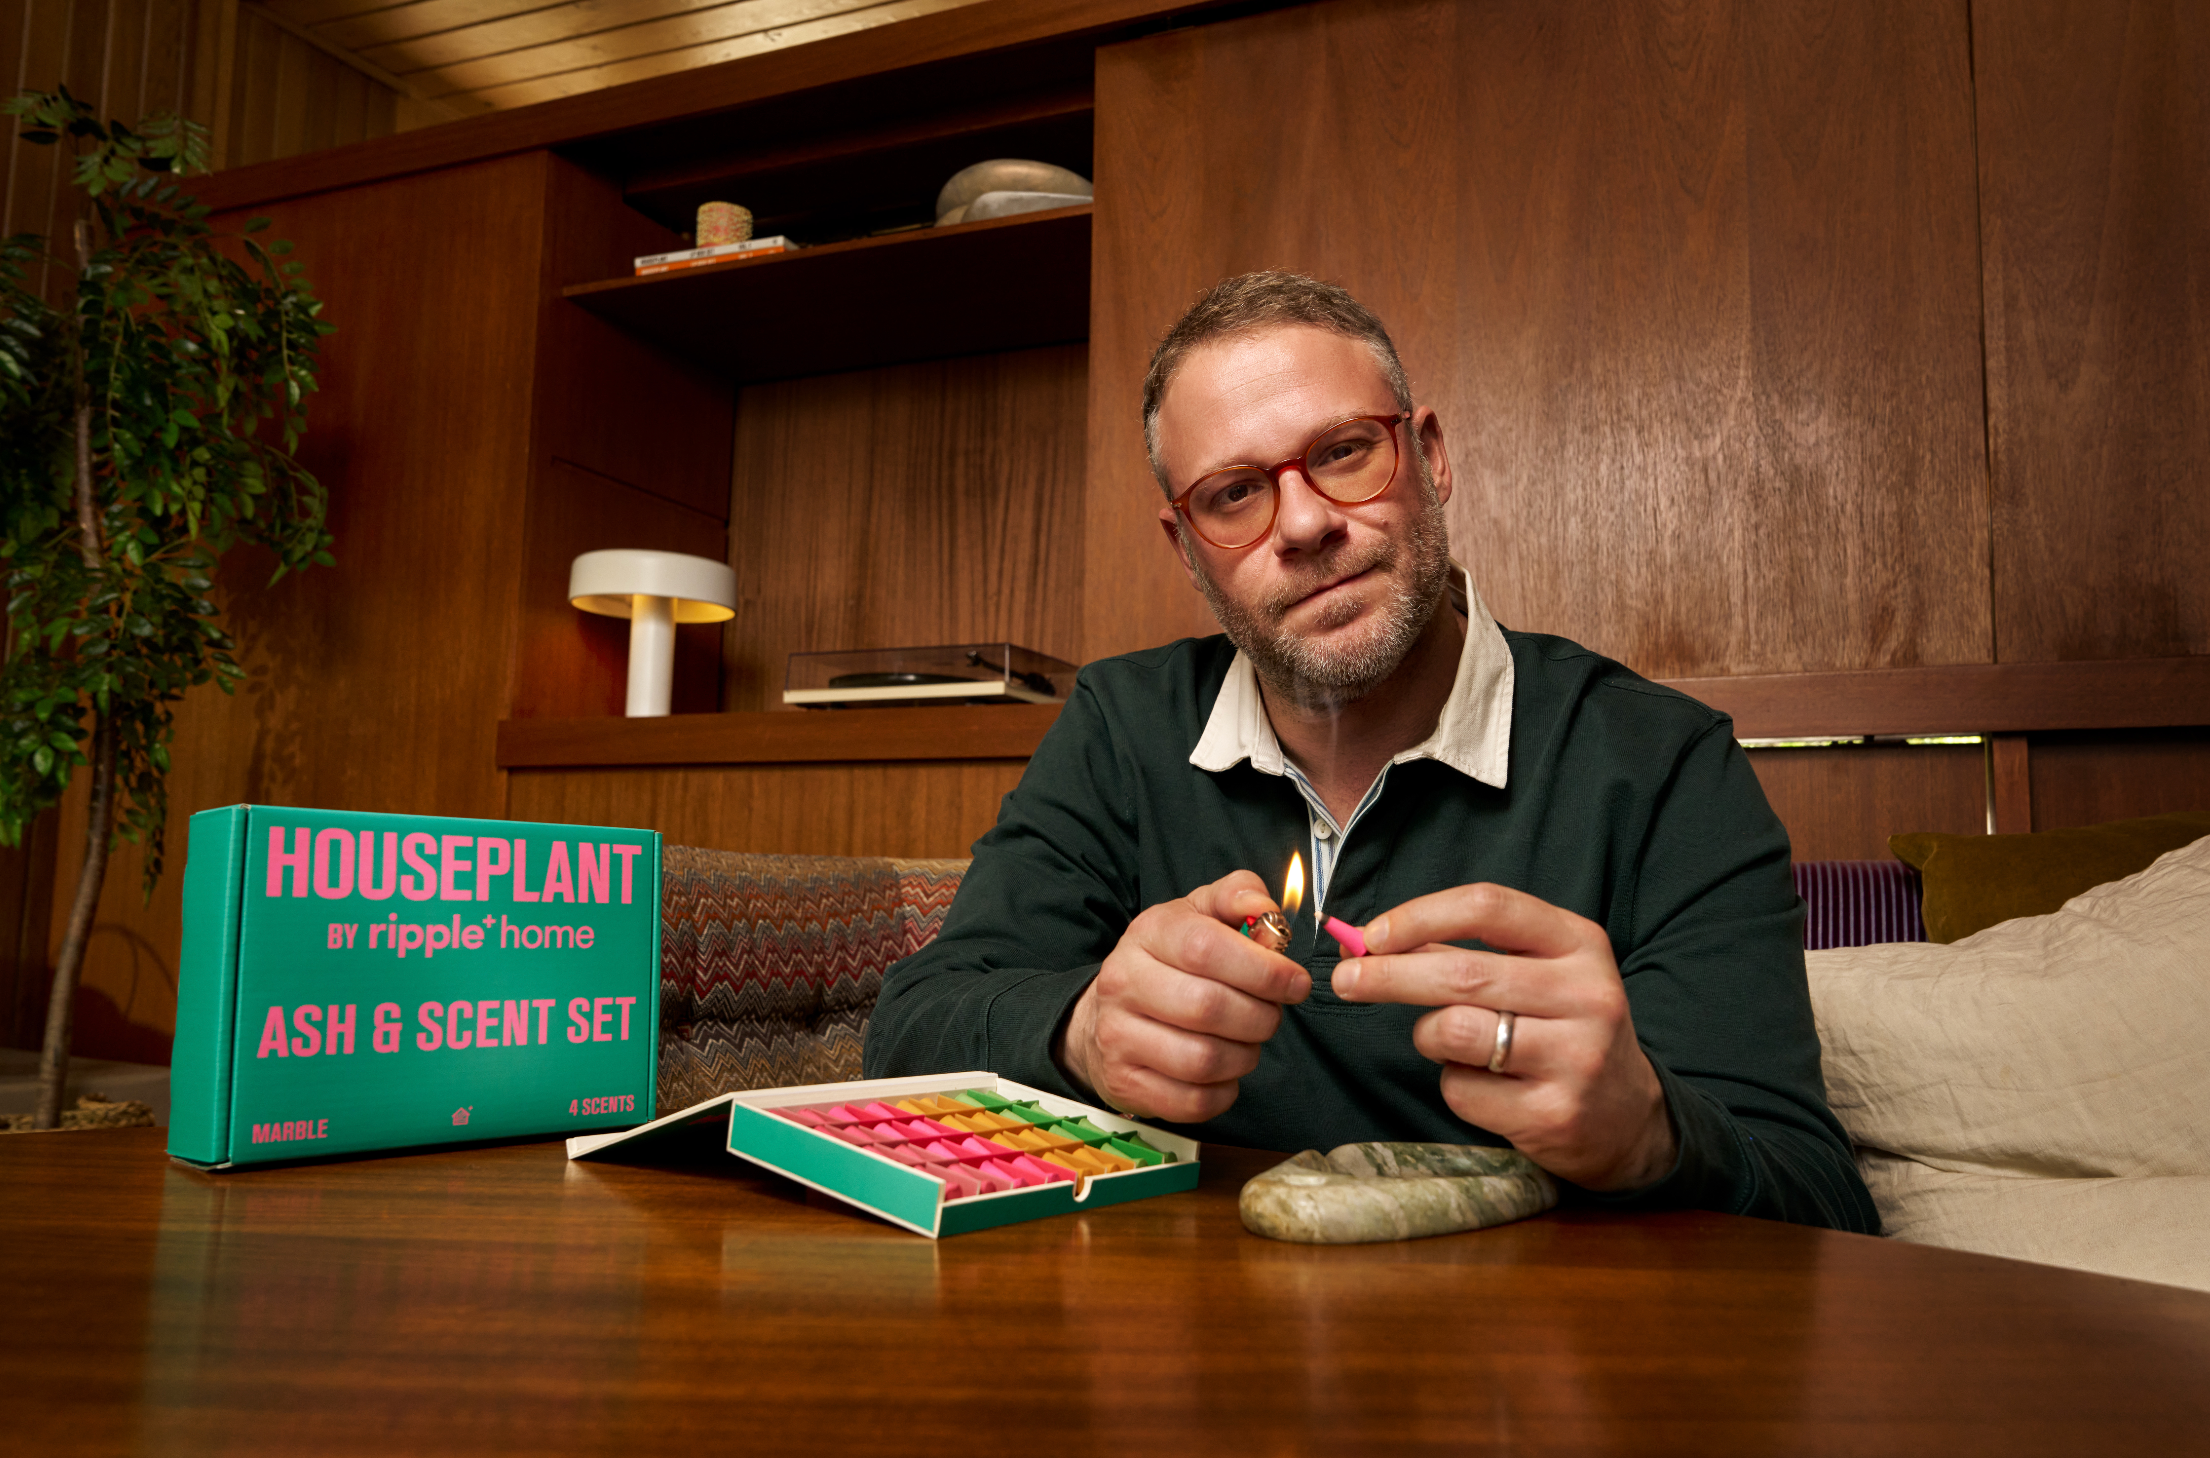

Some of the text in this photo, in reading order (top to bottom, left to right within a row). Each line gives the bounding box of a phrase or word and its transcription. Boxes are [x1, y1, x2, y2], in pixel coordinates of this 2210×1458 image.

[265, 826, 643, 905] HOUSEPLANT
[327, 923, 359, 950] BY
[500, 914, 595, 949] home
[256, 996, 637, 1059] ASH & SCENT SET
[568, 1094, 635, 1117] 4 SCENTS
[251, 1118, 329, 1144] MARBLE
